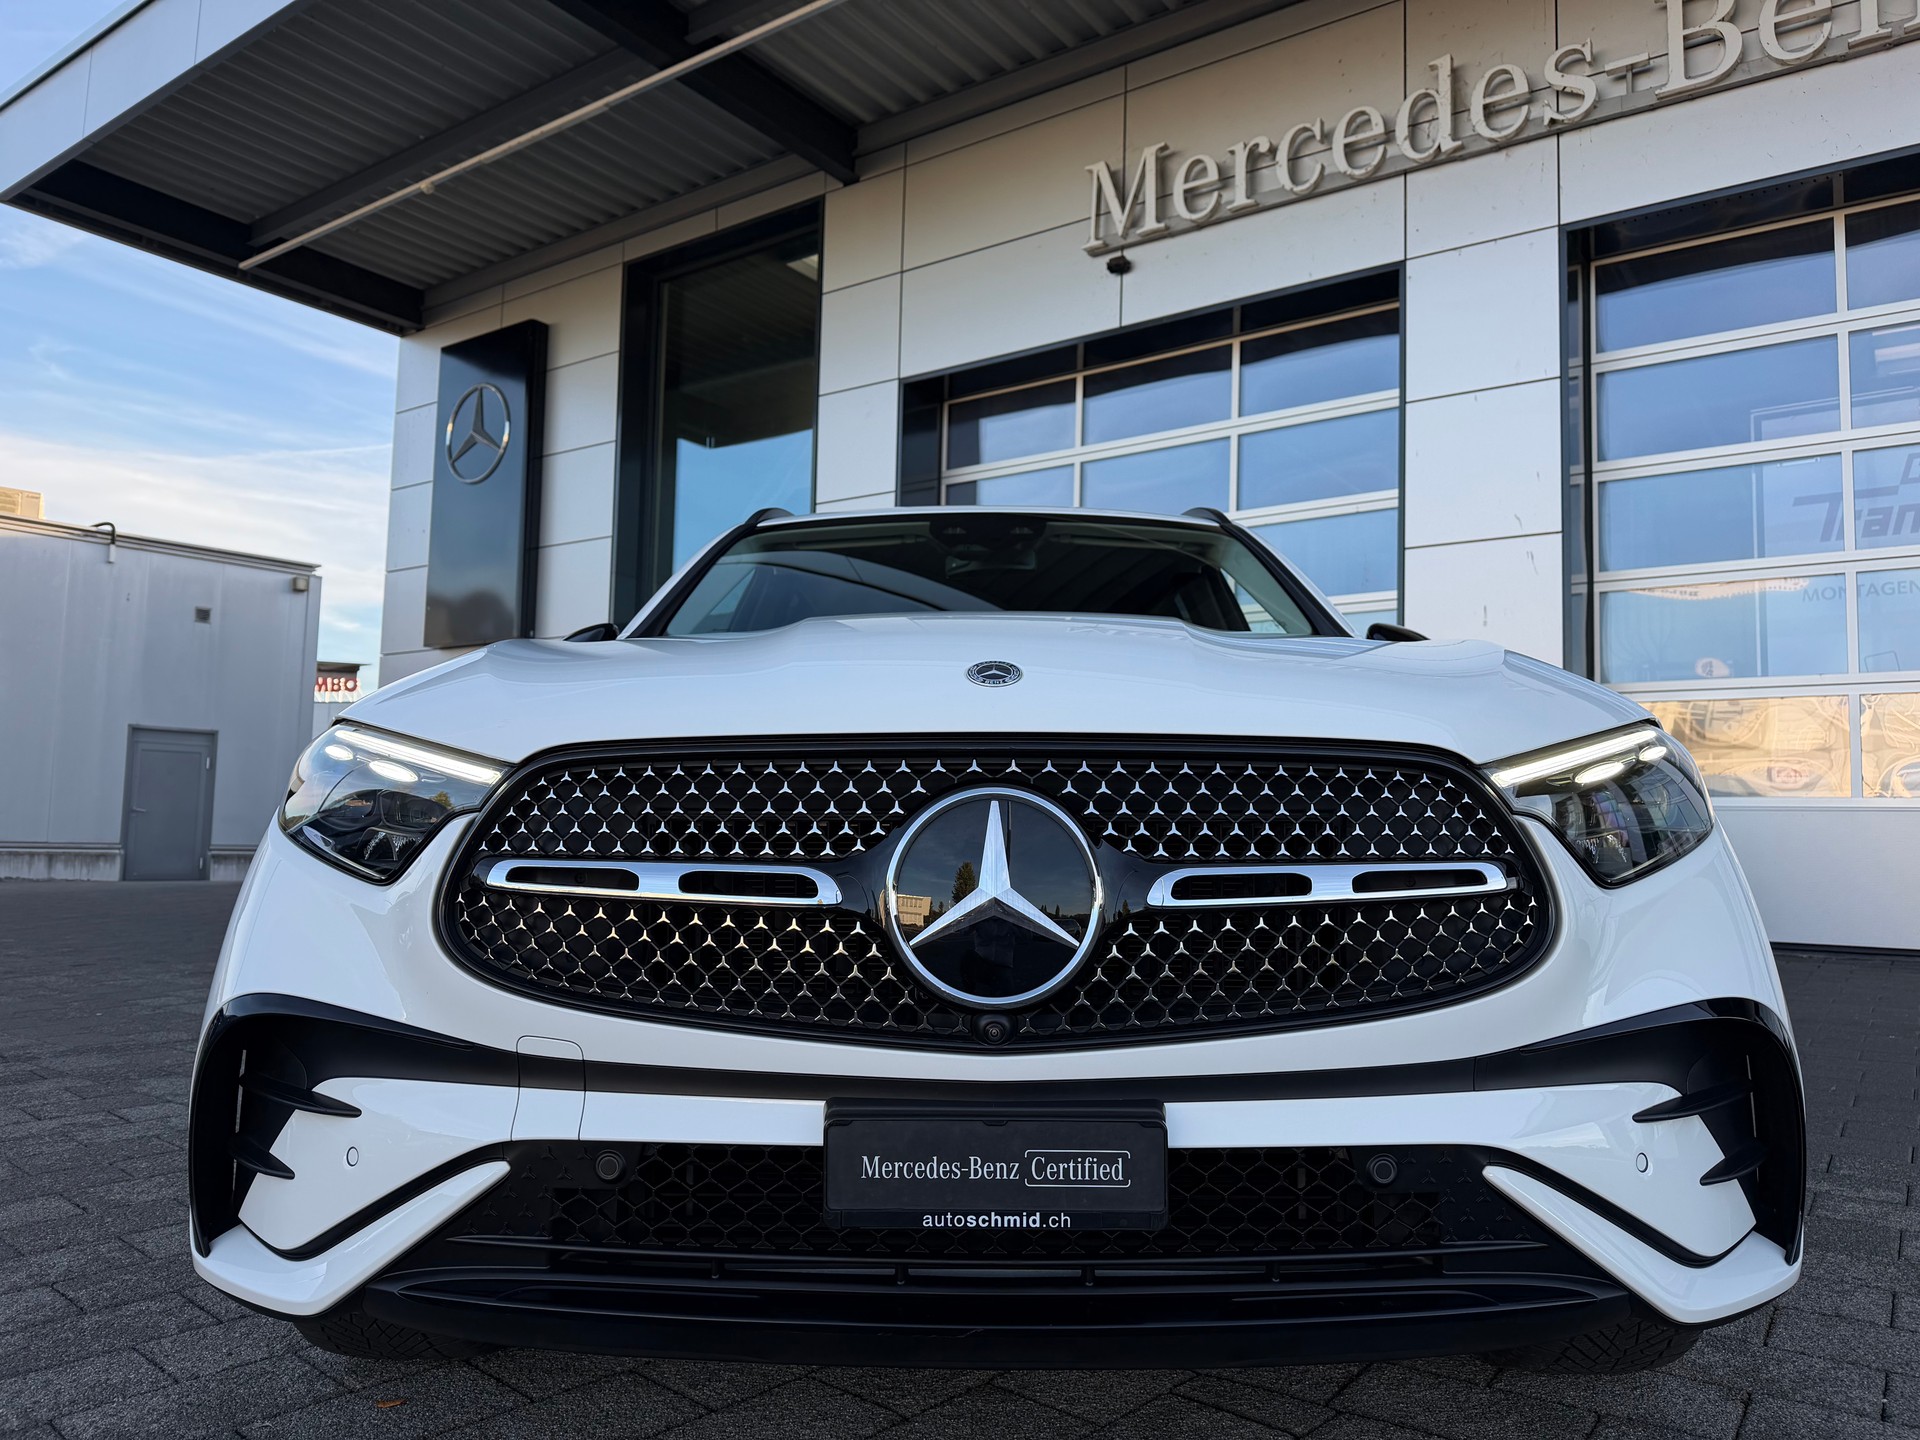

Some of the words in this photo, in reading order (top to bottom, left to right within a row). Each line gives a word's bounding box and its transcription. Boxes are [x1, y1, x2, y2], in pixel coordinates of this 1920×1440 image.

[860, 1155, 1020, 1180] Mercedes-Benz
[1031, 1156, 1124, 1181] Certified
[922, 1211, 1071, 1228] autoschmid.ch
